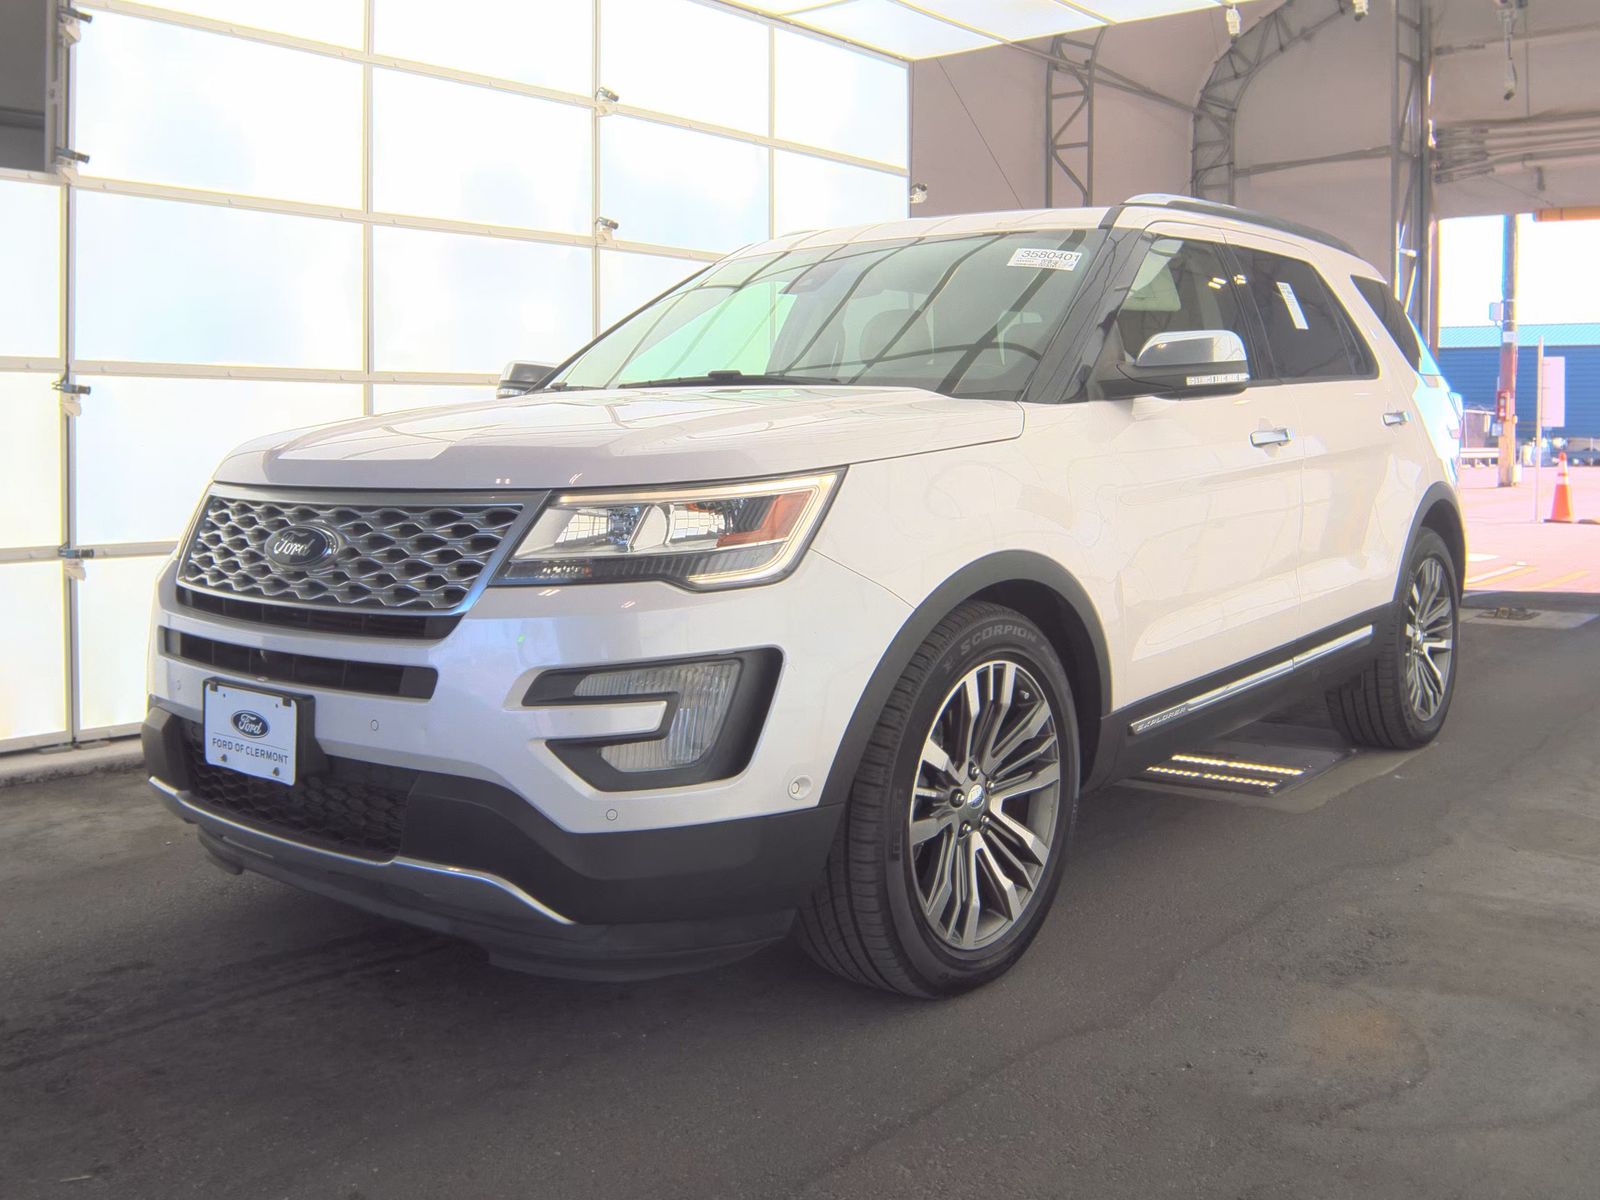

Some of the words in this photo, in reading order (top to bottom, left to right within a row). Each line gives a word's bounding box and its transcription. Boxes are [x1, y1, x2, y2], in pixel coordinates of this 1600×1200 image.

[1021, 250, 1080, 261] 3580401
[273, 530, 316, 556] Ford
[960, 624, 1037, 655] SCORPION
[238, 713, 263, 734] Ford
[212, 738, 233, 750] FORD
[235, 743, 244, 752] OF
[245, 746, 288, 764] CLERMONT
